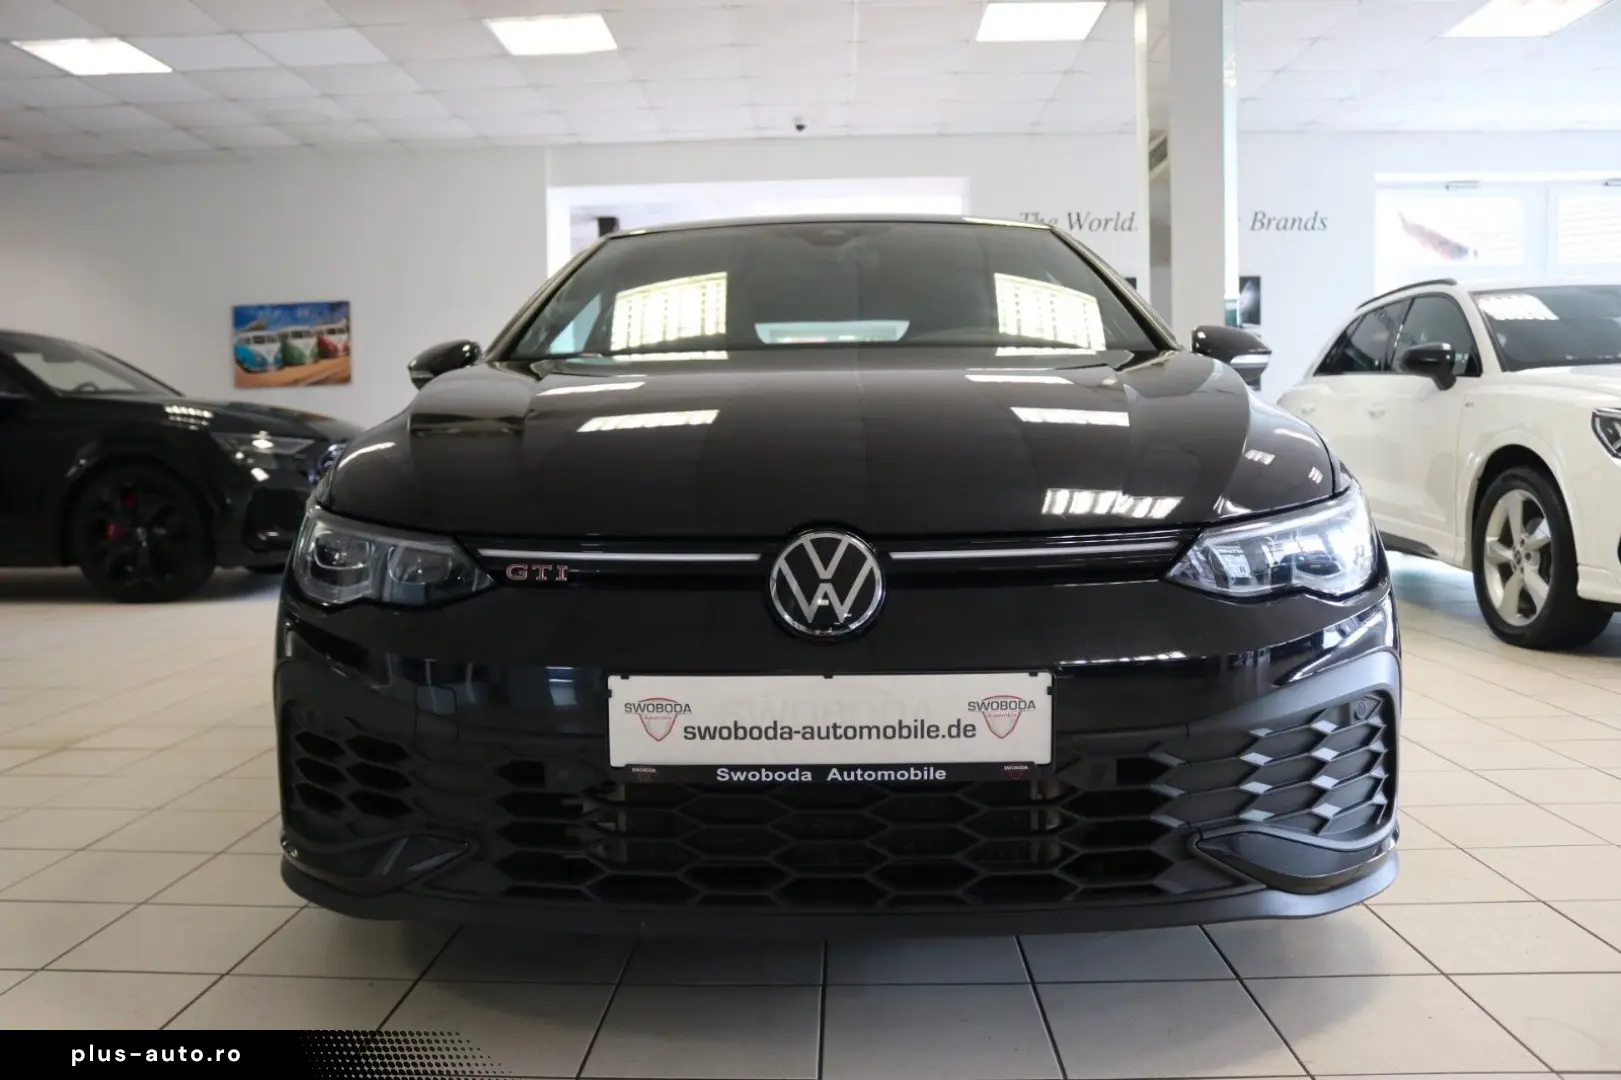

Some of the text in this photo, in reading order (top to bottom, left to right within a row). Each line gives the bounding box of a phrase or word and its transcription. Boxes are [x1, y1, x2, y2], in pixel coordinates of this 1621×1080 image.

[1249, 210, 1328, 231] Brands
[506, 563, 568, 581] GTI
[624, 703, 692, 713] SWOBODA
[967, 700, 1036, 711] SWOBODA
[683, 718, 977, 742] swoboda-automobile.de
[716, 767, 947, 782] Swoboda Automobile
